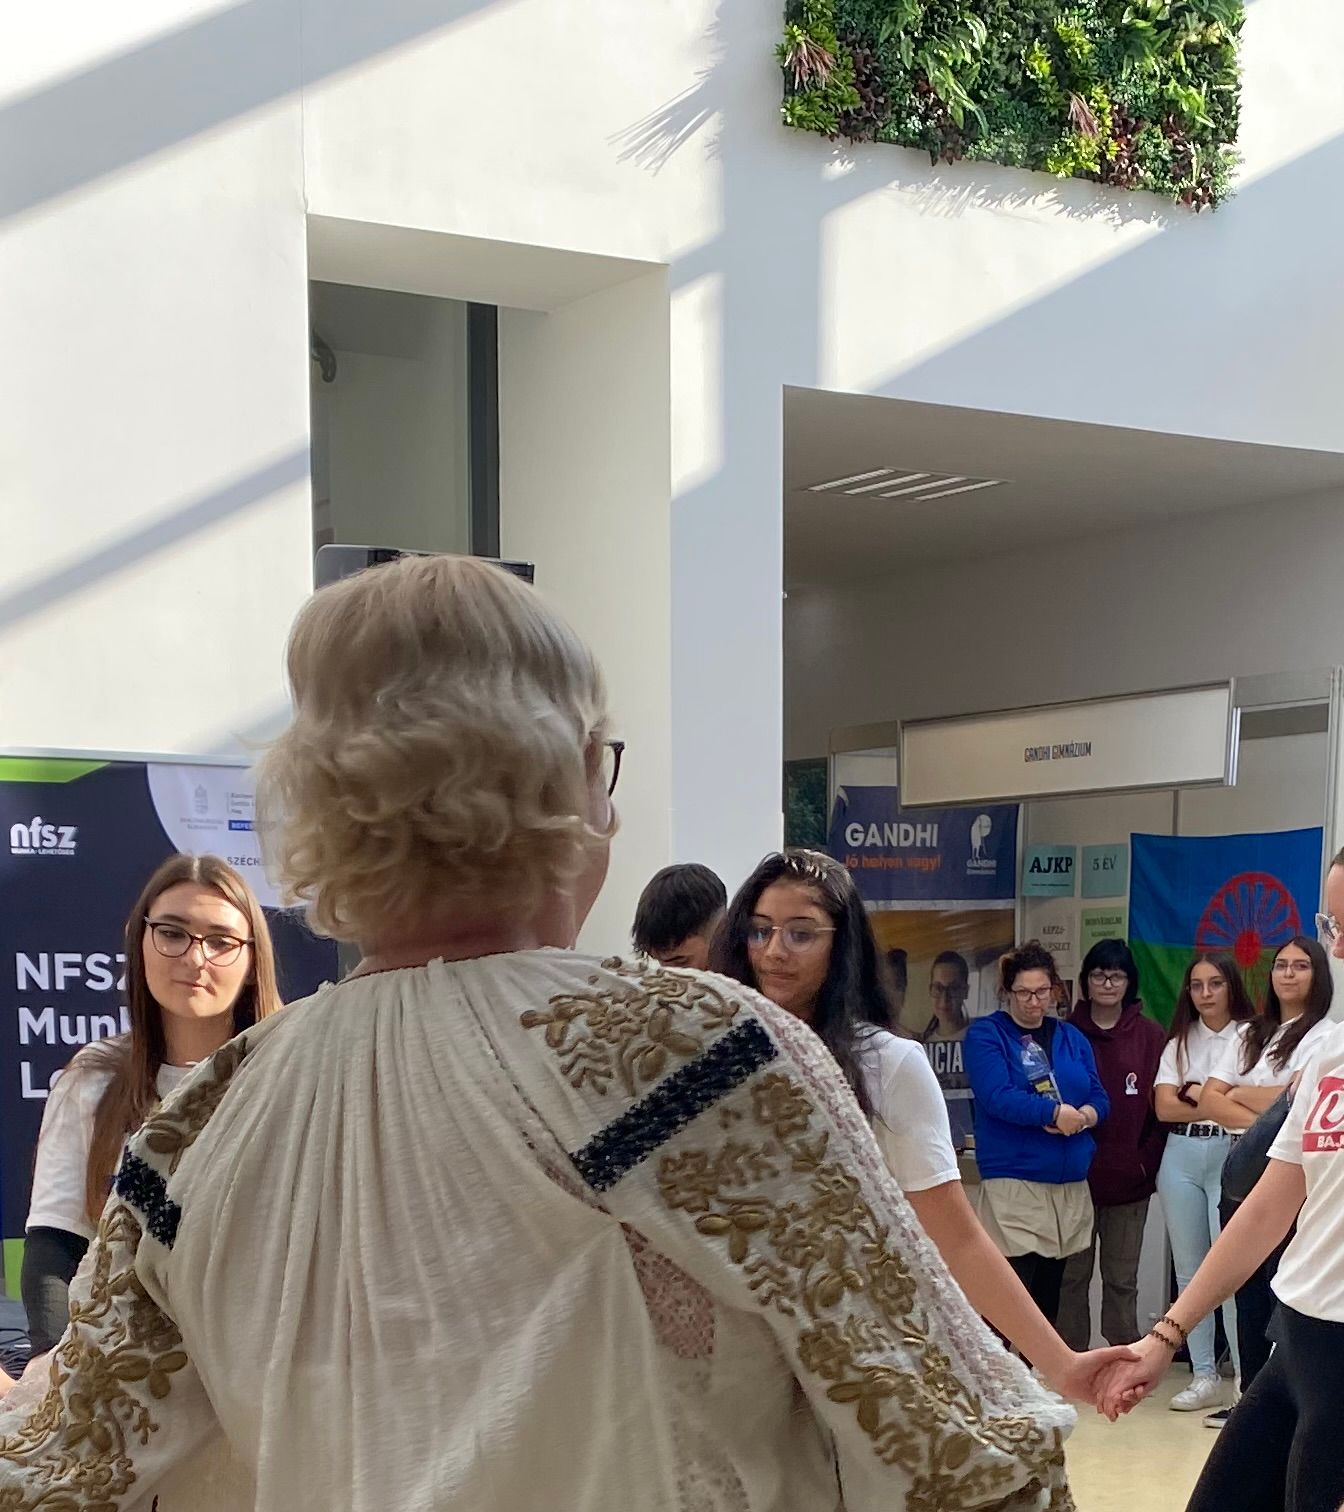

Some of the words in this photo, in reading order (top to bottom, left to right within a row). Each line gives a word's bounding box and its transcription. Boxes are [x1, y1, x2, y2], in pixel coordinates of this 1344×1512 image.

[10, 816, 76, 848] nfsz
[845, 822, 939, 848] GANDHI
[1029, 857, 1073, 873] AJKP
[1093, 858, 1099, 871] 5
